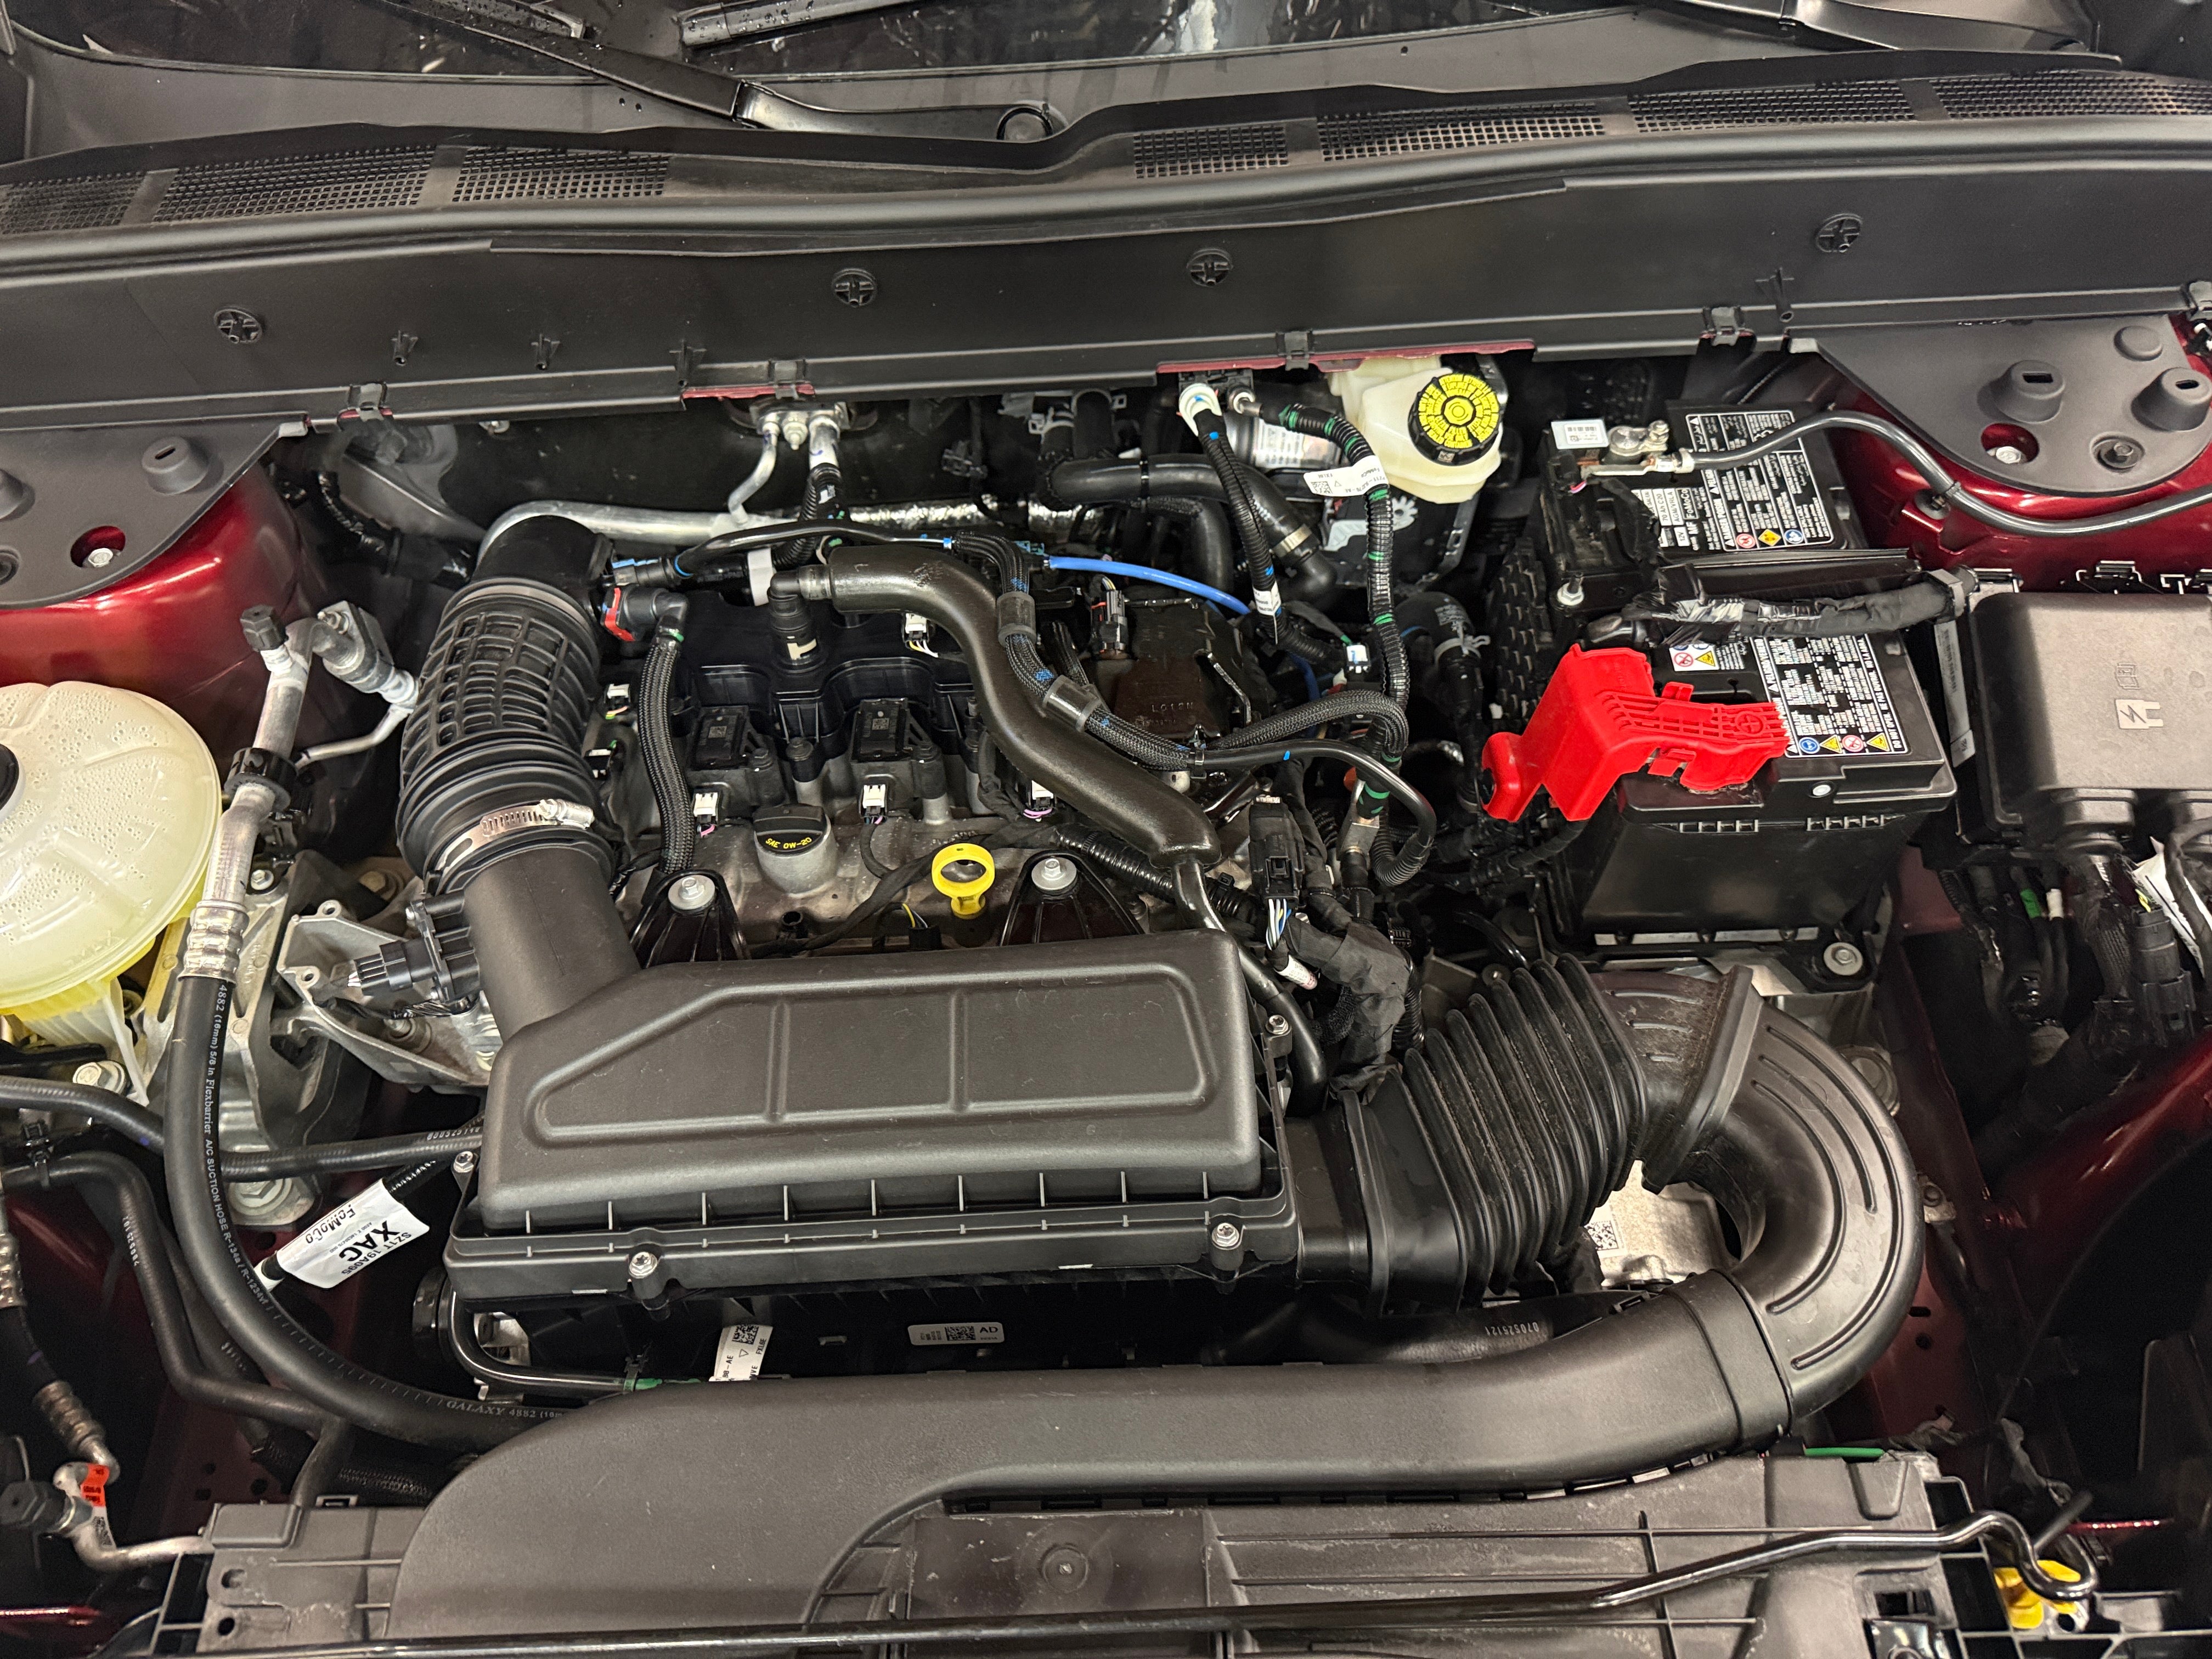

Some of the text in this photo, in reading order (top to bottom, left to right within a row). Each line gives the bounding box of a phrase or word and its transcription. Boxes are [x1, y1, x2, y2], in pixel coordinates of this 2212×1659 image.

[1655, 493, 1664, 504] C20
[1666, 491, 1681, 522] AGM/VRLA
[1678, 488, 1696, 518] FoMoCo
[1677, 531, 1686, 541] 12V
[1685, 520, 1700, 534] MF
[1753, 638, 1777, 684] PELIGRO/VENENO
[1875, 692, 1887, 702] PAS
[1882, 712, 1895, 727] OPEN.
[1887, 728, 1900, 740] NOT
[1892, 740, 1903, 748] DO
[765, 837, 812, 849] SAE 0W-20
[216, 984, 228, 1011] 4882
[210, 1015, 223, 1049] (16mm)
[208, 1051, 217, 1065] 5/8
[204, 1079, 215, 1134] Flexbarrier
[205, 1139, 213, 1155] A/C
[206, 1158, 221, 1203] SUCTION
[215, 1204, 229, 1231] HOSE
[305, 1204, 357, 1244] FoMoCo
[223, 1232, 240, 1263] R-134a
[338, 1220, 400, 1261] XAC
[341, 1250, 382, 1274] 19A095
[446, 1400, 505, 1415] GALAXY
[509, 1408, 536, 1418] 4882
